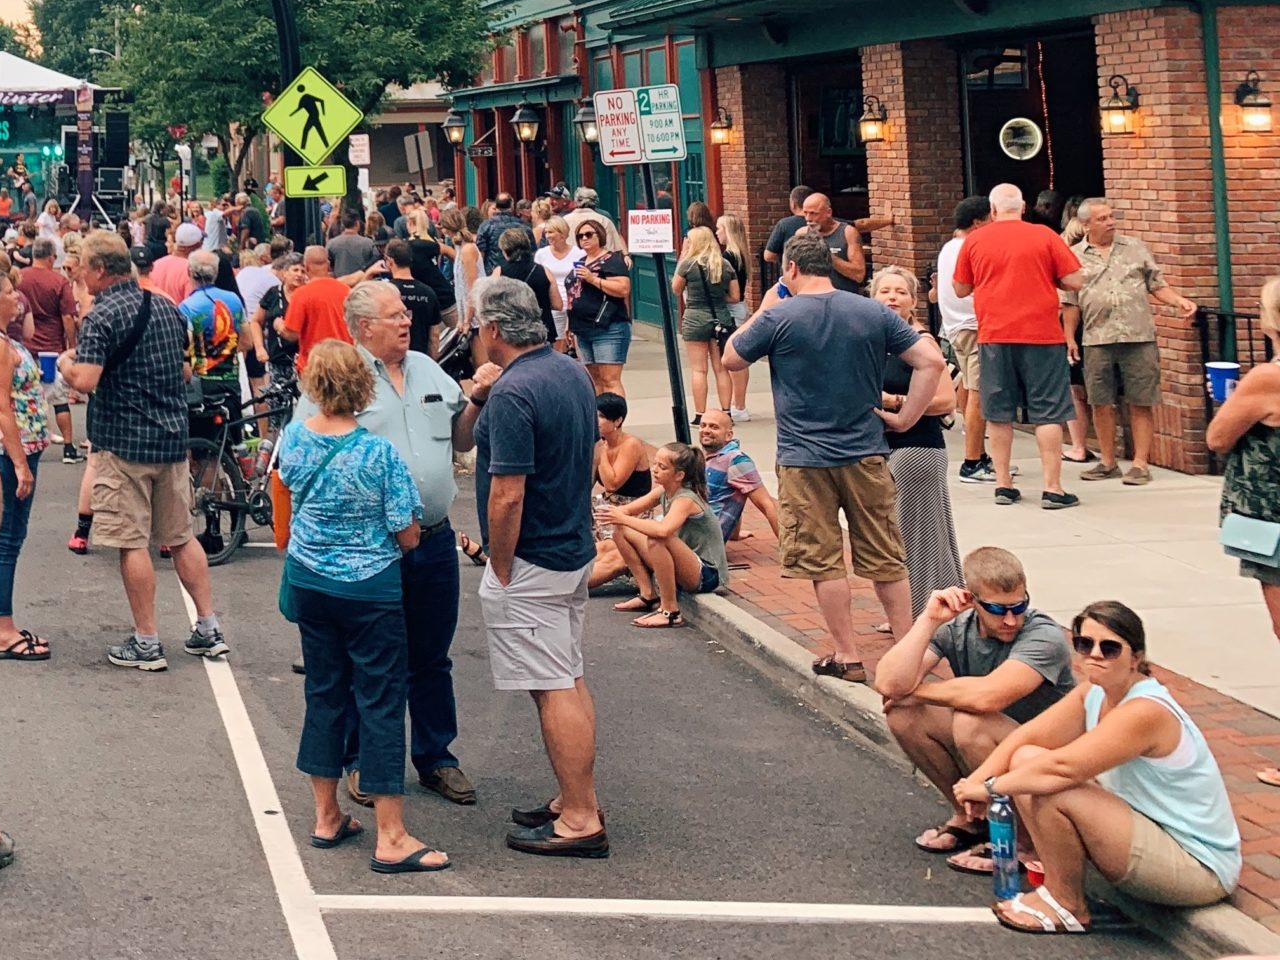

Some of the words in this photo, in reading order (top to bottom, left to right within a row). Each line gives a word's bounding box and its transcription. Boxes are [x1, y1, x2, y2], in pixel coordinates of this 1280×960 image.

[607, 97, 623, 110] NO
[640, 93, 649, 112] 2
[658, 90, 669, 100] HR
[651, 100, 678, 111] PARKING
[600, 112, 636, 127] PARKING
[649, 120, 663, 129] 9:00
[664, 118, 674, 128] AM
[611, 127, 627, 137] ANY
[647, 134, 656, 143] TO
[656, 132, 670, 142] 6:00
[670, 131, 680, 141] PM
[611, 138, 631, 148] TIME
[630, 215, 640, 224] NO
[641, 213, 671, 224] PARKING
